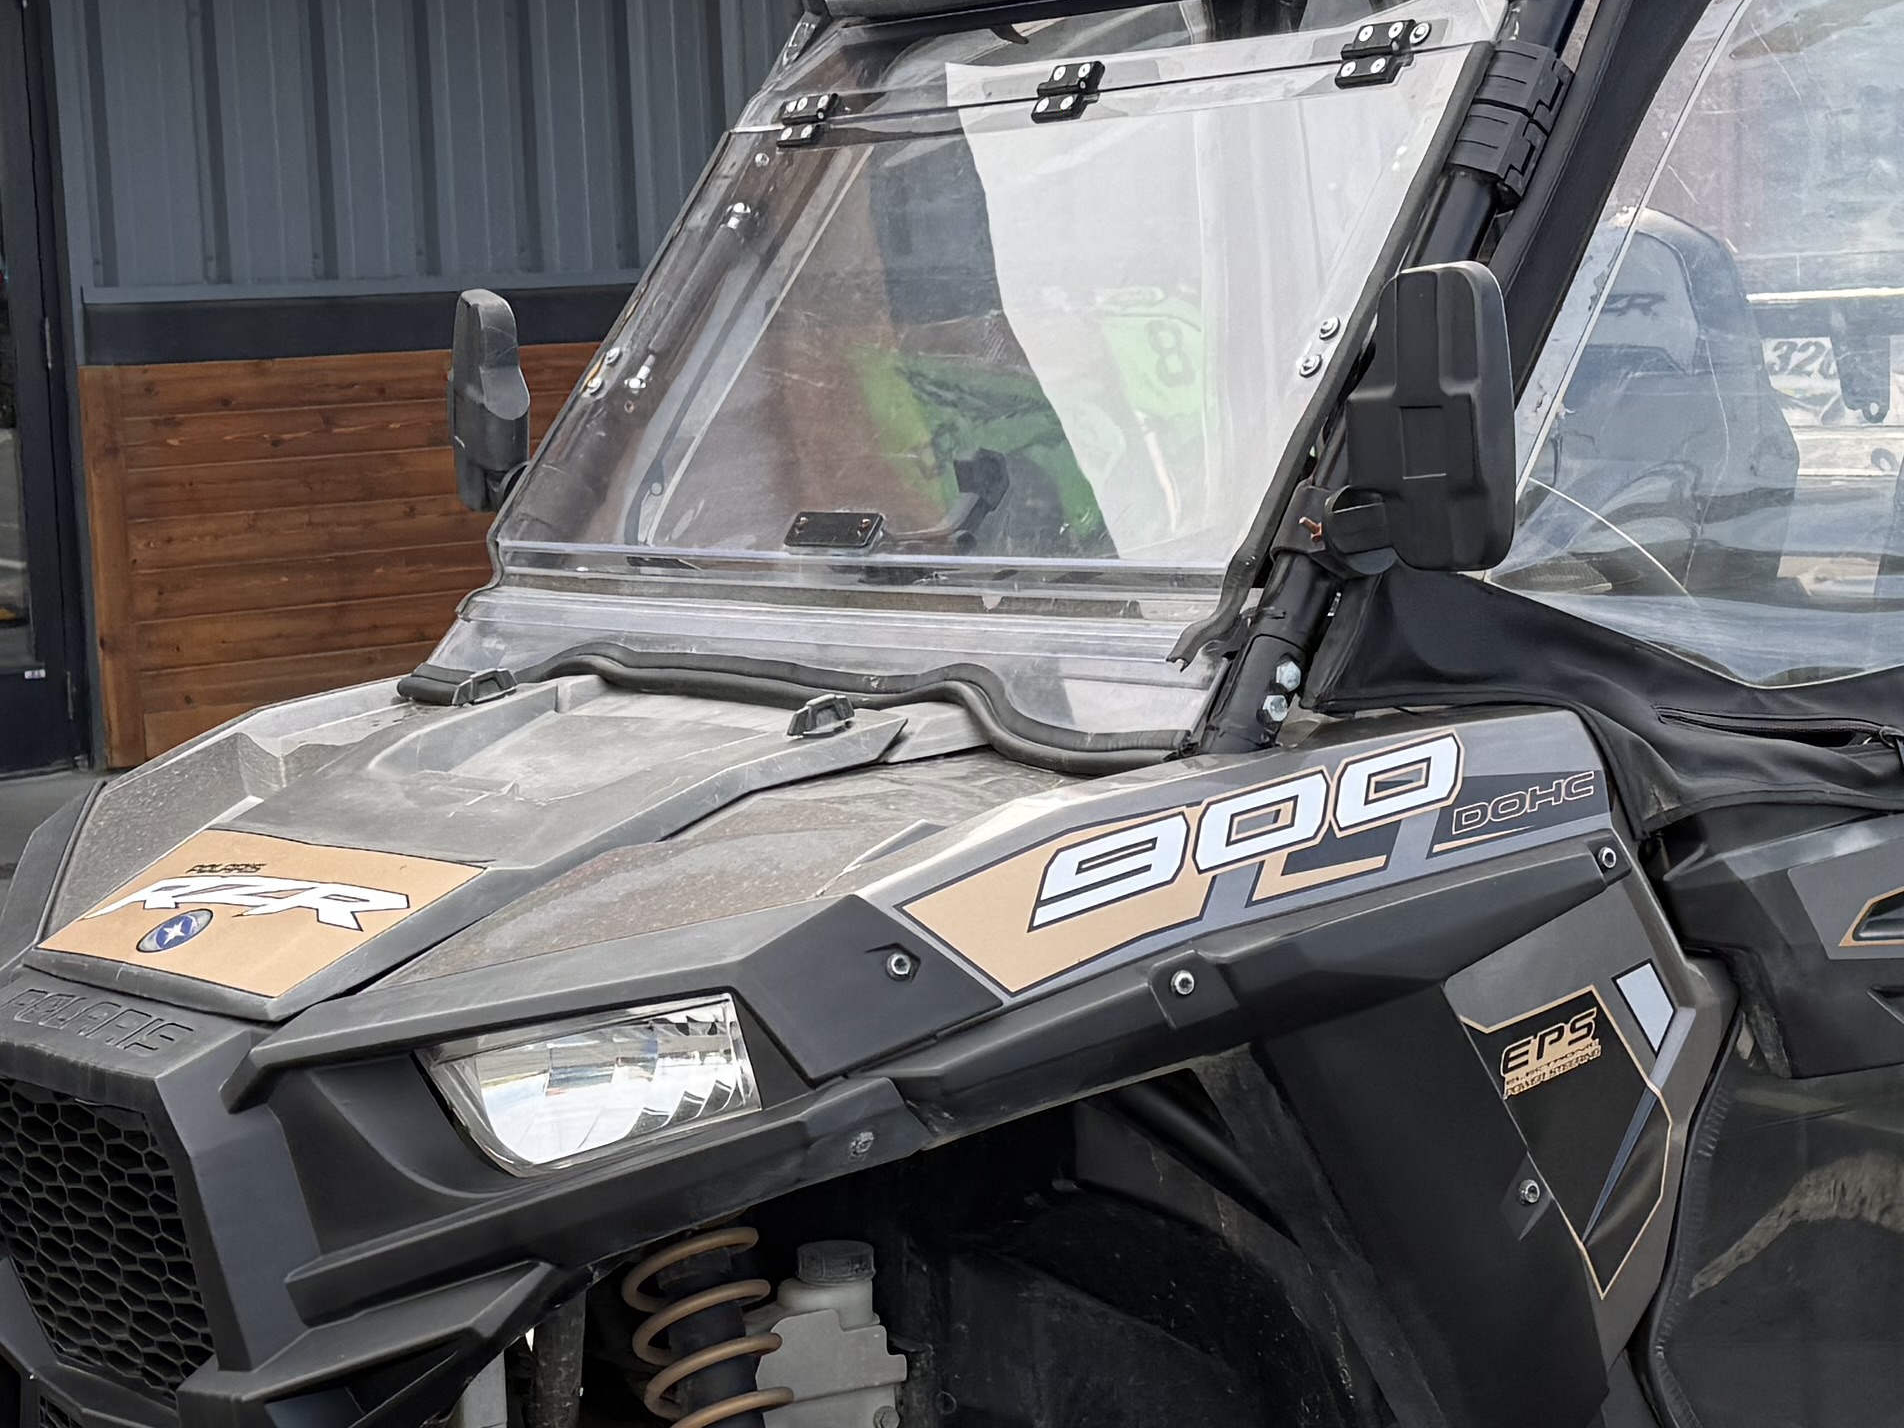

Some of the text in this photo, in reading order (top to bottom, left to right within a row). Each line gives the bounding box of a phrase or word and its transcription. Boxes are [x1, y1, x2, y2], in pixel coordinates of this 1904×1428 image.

[1028, 731, 1464, 933] 900
[1451, 771, 1596, 836] DOHC
[79, 875, 411, 933] RZR
[1501, 1007, 1597, 1076] EPS
